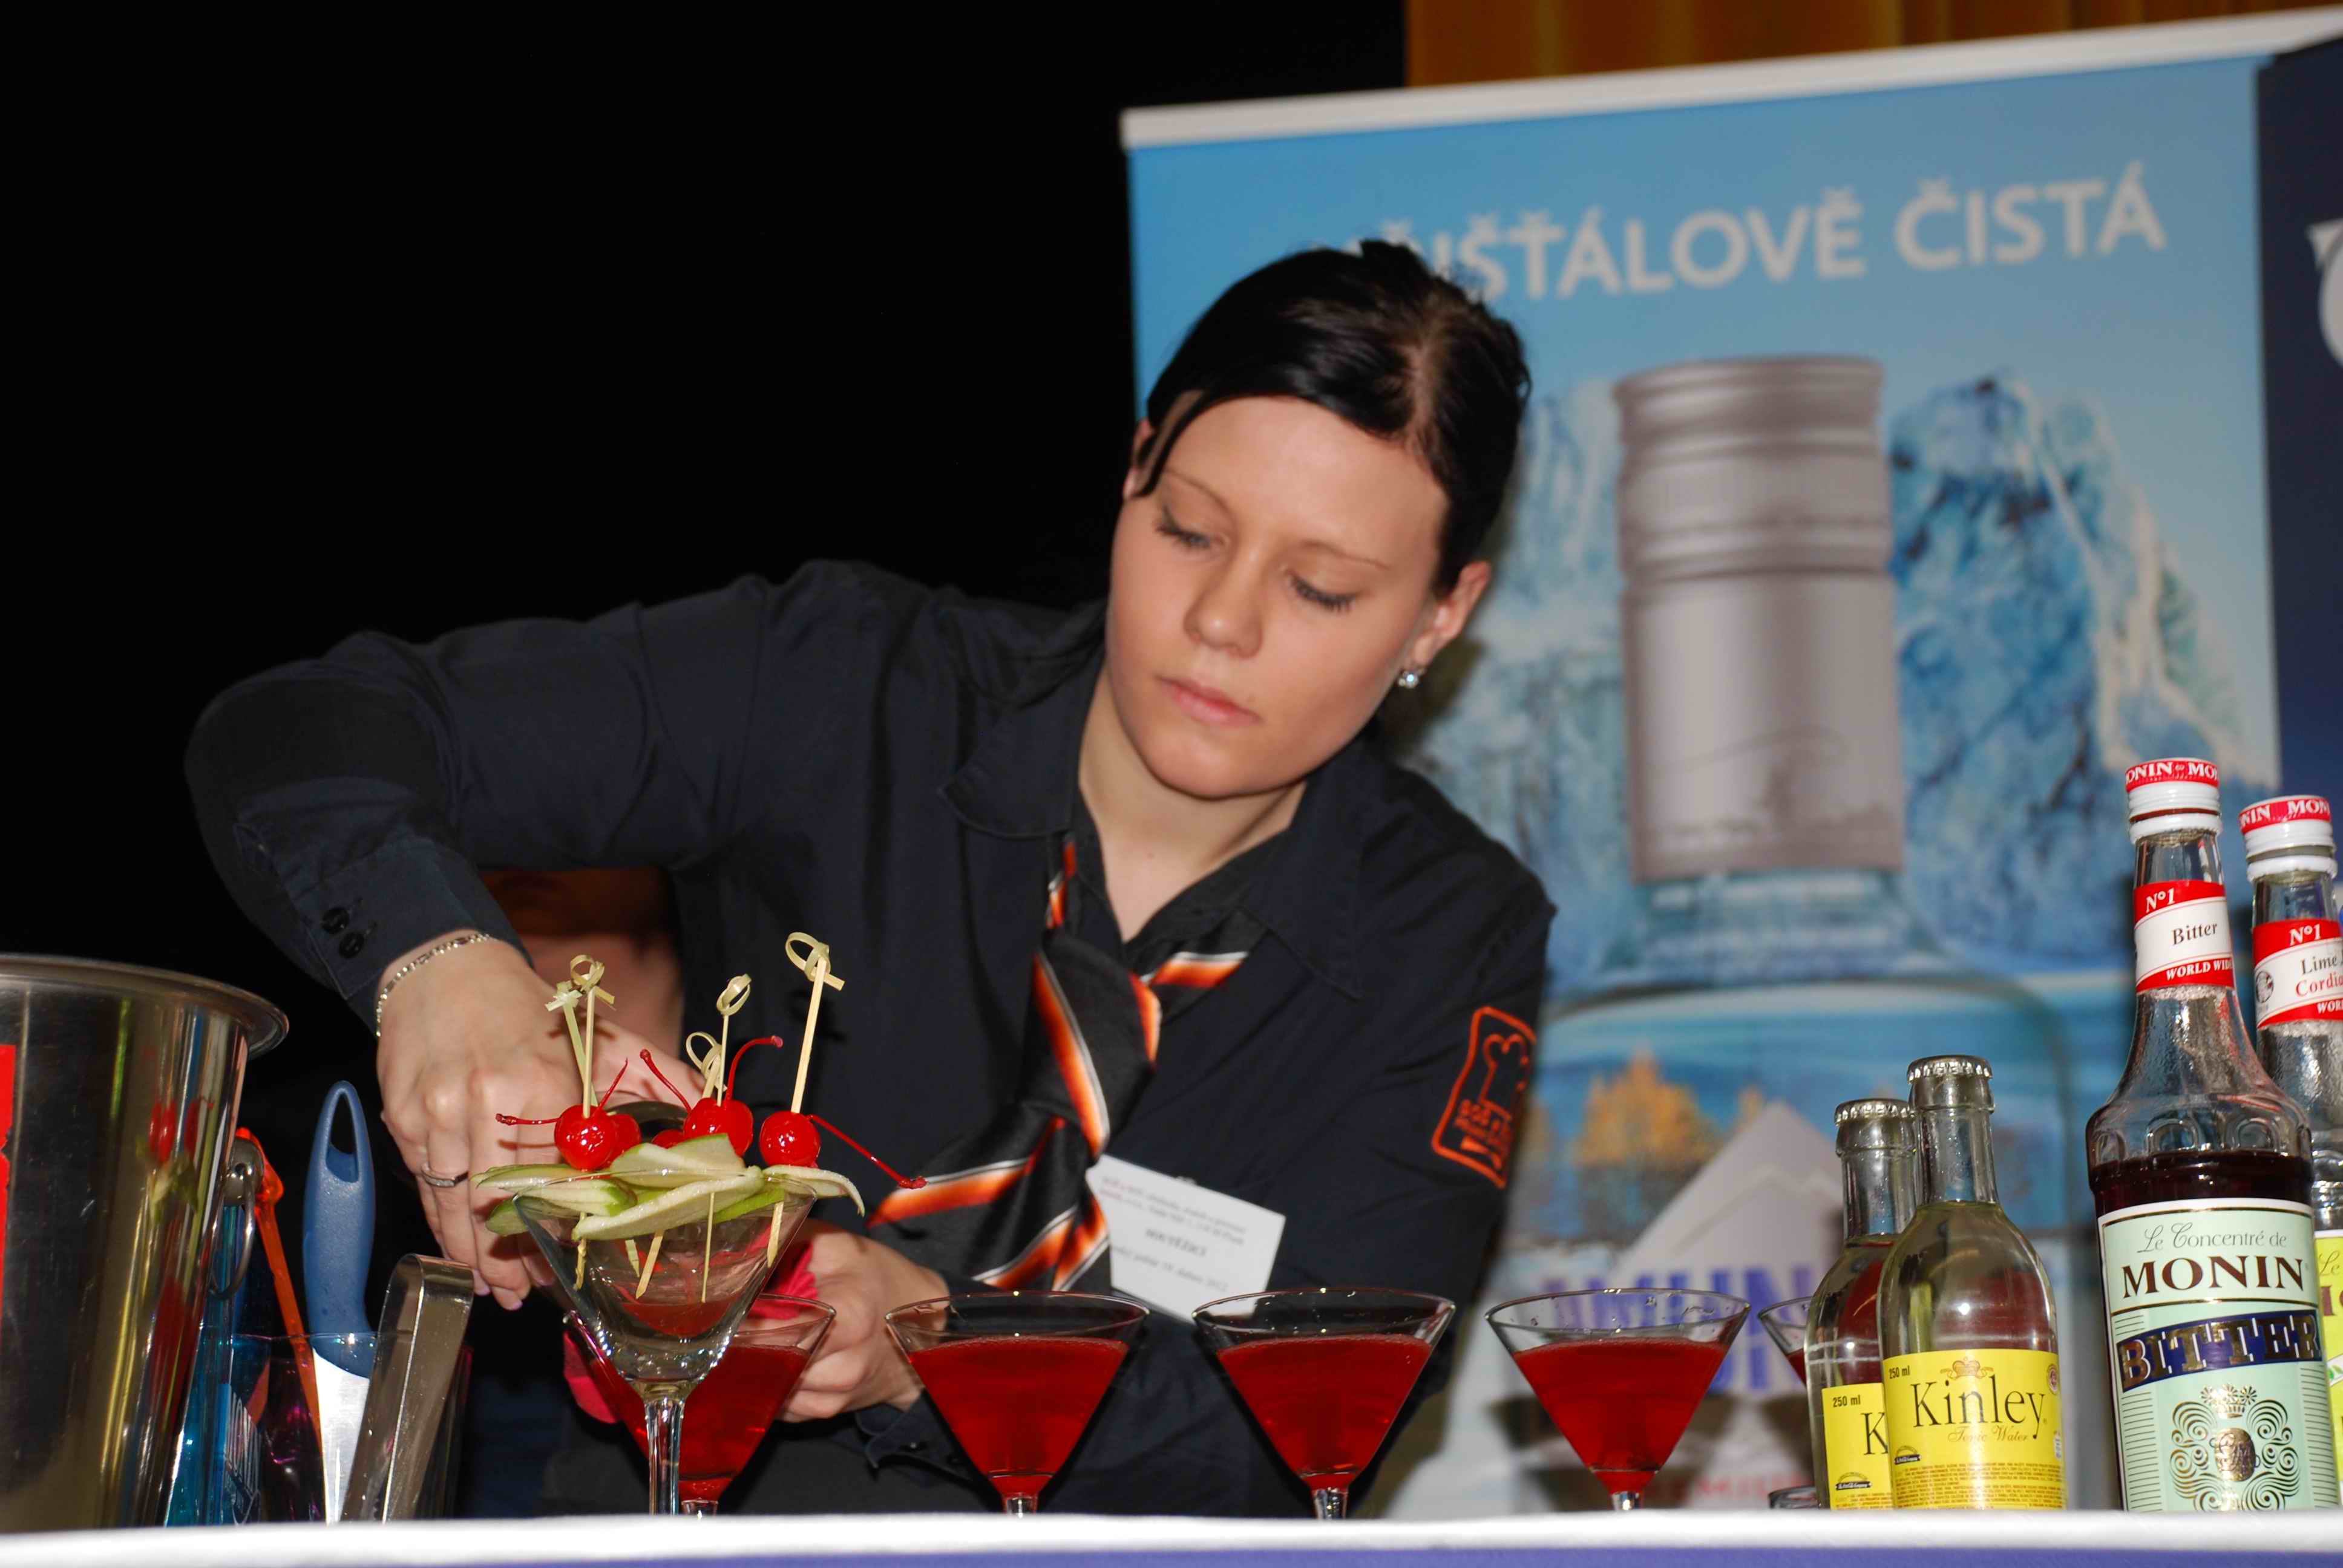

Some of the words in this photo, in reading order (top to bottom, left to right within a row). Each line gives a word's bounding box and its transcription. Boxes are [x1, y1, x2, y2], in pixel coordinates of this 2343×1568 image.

[1351, 186, 1866, 302] IŠŤÁLOVĚ
[1894, 160, 2168, 270] ČISTÁ
[2125, 761, 2173, 785] ONIN
[2172, 923, 2218, 945] Bitter
[2166, 961, 2211, 981] WORLD
[2301, 956, 2338, 975] Lime
[2137, 1224, 2164, 1253] Le
[2171, 1222, 2264, 1249] Concentré
[2269, 1231, 2287, 1248] de
[2319, 1250, 2341, 1277] Le
[2120, 1255, 2304, 1299] MONIN
[2120, 1314, 2319, 1389] BITTER
[1889, 1367, 1901, 1380] 250
[1902, 1365, 1910, 1377] ml
[1832, 1395, 1848, 1408] 250
[1850, 1394, 1861, 1406] ml
[1910, 1375, 2045, 1440] Kinley
[1860, 1411, 1889, 1455] K
[1991, 1424, 2029, 1442] Water
